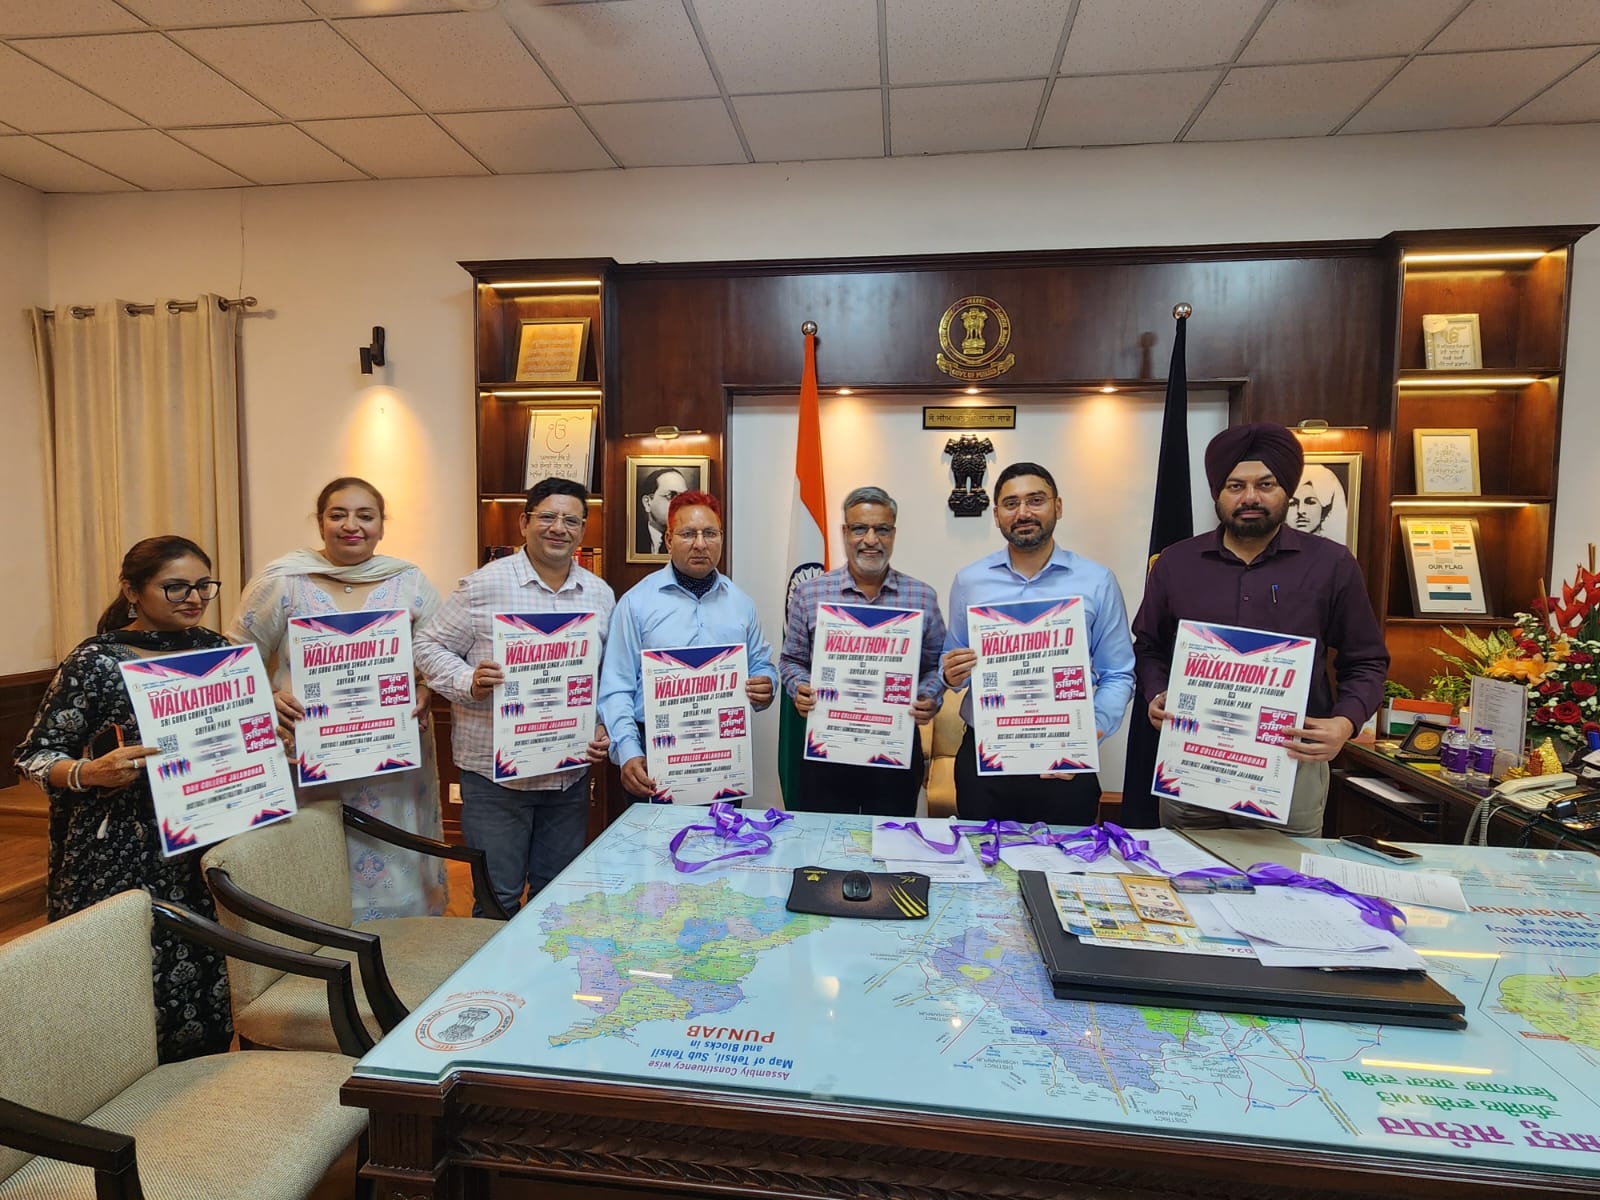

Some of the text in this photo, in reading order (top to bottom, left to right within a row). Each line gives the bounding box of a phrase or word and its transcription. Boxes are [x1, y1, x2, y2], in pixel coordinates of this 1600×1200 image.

[303, 640, 333, 648] DAV
[824, 636, 910, 654] WALKATHON 1.0
[982, 628, 1073, 655] WALKATHON 1.0
[304, 637, 398, 667] WALKATHON 1.0
[505, 640, 588, 665] WALKATHON 1.0
[1184, 658, 1296, 688] WALKATHON 1.0
[148, 685, 181, 697] DAV
[655, 672, 737, 698] WALKATHON 1.0
[1213, 682, 1234, 690] GOBIND
[1259, 688, 1285, 696] STADIUM
[149, 676, 256, 718] WALKATHON 1.0
[1185, 744, 1200, 752] DAV
[1199, 746, 1227, 758] COLLEGE
[1226, 752, 1265, 766] JALANDHAR
[1469, 906, 1592, 922] Jalandhar
[1485, 924, 1599, 939] onstituency
[1539, 918, 1584, 929] Map
[686, 1026, 775, 1043] PUNJAB
[690, 1040, 762, 1053] and Blocks in
[651, 1048, 793, 1069] Map of Tehsil, Sub Tehsil
[648, 1060, 790, 1080] Assembly Constituency wise
[1406, 1076, 1459, 1090] ਹਲਕਾ
[1376, 1091, 1414, 1106] ਅਤੇ
[1377, 1116, 1514, 1148] ਜਲੰਧਰ
